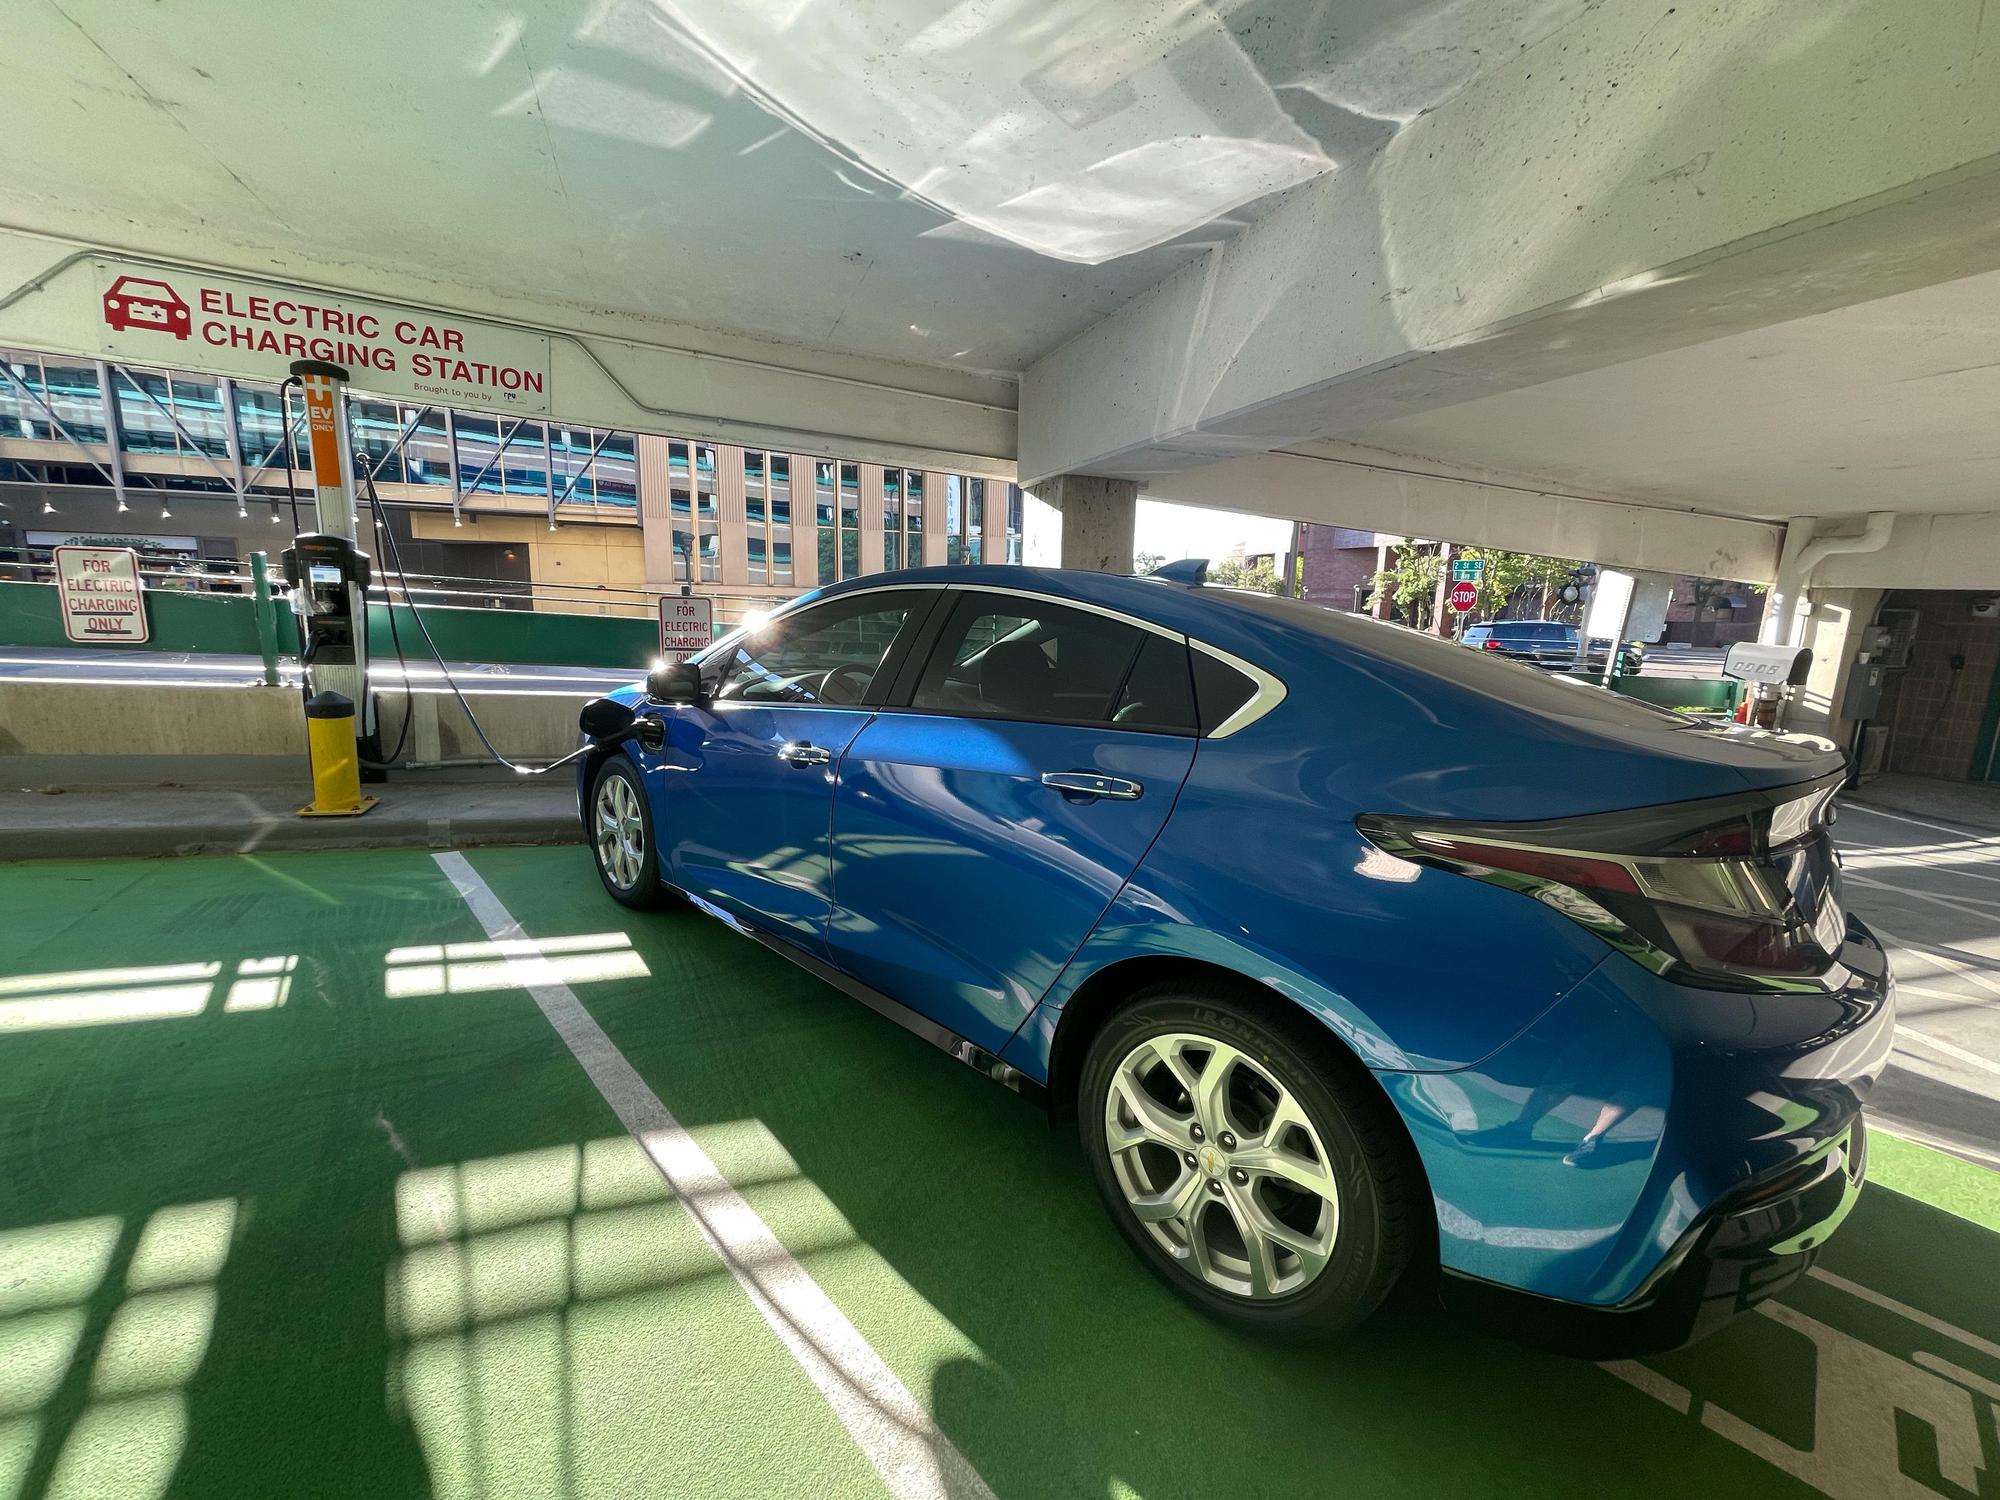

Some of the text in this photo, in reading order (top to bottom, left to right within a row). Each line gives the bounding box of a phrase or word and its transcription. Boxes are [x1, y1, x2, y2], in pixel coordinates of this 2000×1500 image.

[200, 288, 464, 353] ELECTRIC CAR
[202, 321, 543, 393] CHARGING STATION
[414, 382, 492, 402] Brought to you by
[503, 391, 517, 401] rpu
[310, 406, 332, 420] EV
[312, 423, 334, 432] ONLY
[83, 559, 111, 573] FOR
[1463, 561, 1470, 569] St
[1474, 561, 1483, 569] SE
[67, 578, 133, 593] ELECTRIC
[1453, 591, 1476, 602] STOP
[69, 598, 138, 612] CHARGING
[676, 606, 695, 616] FOR
[88, 617, 124, 631] ONLY
[665, 621, 708, 632] ELECTRIC
[665, 637, 710, 647] CHARGING
[1192, 1007, 1311, 1087] IRONMAN
